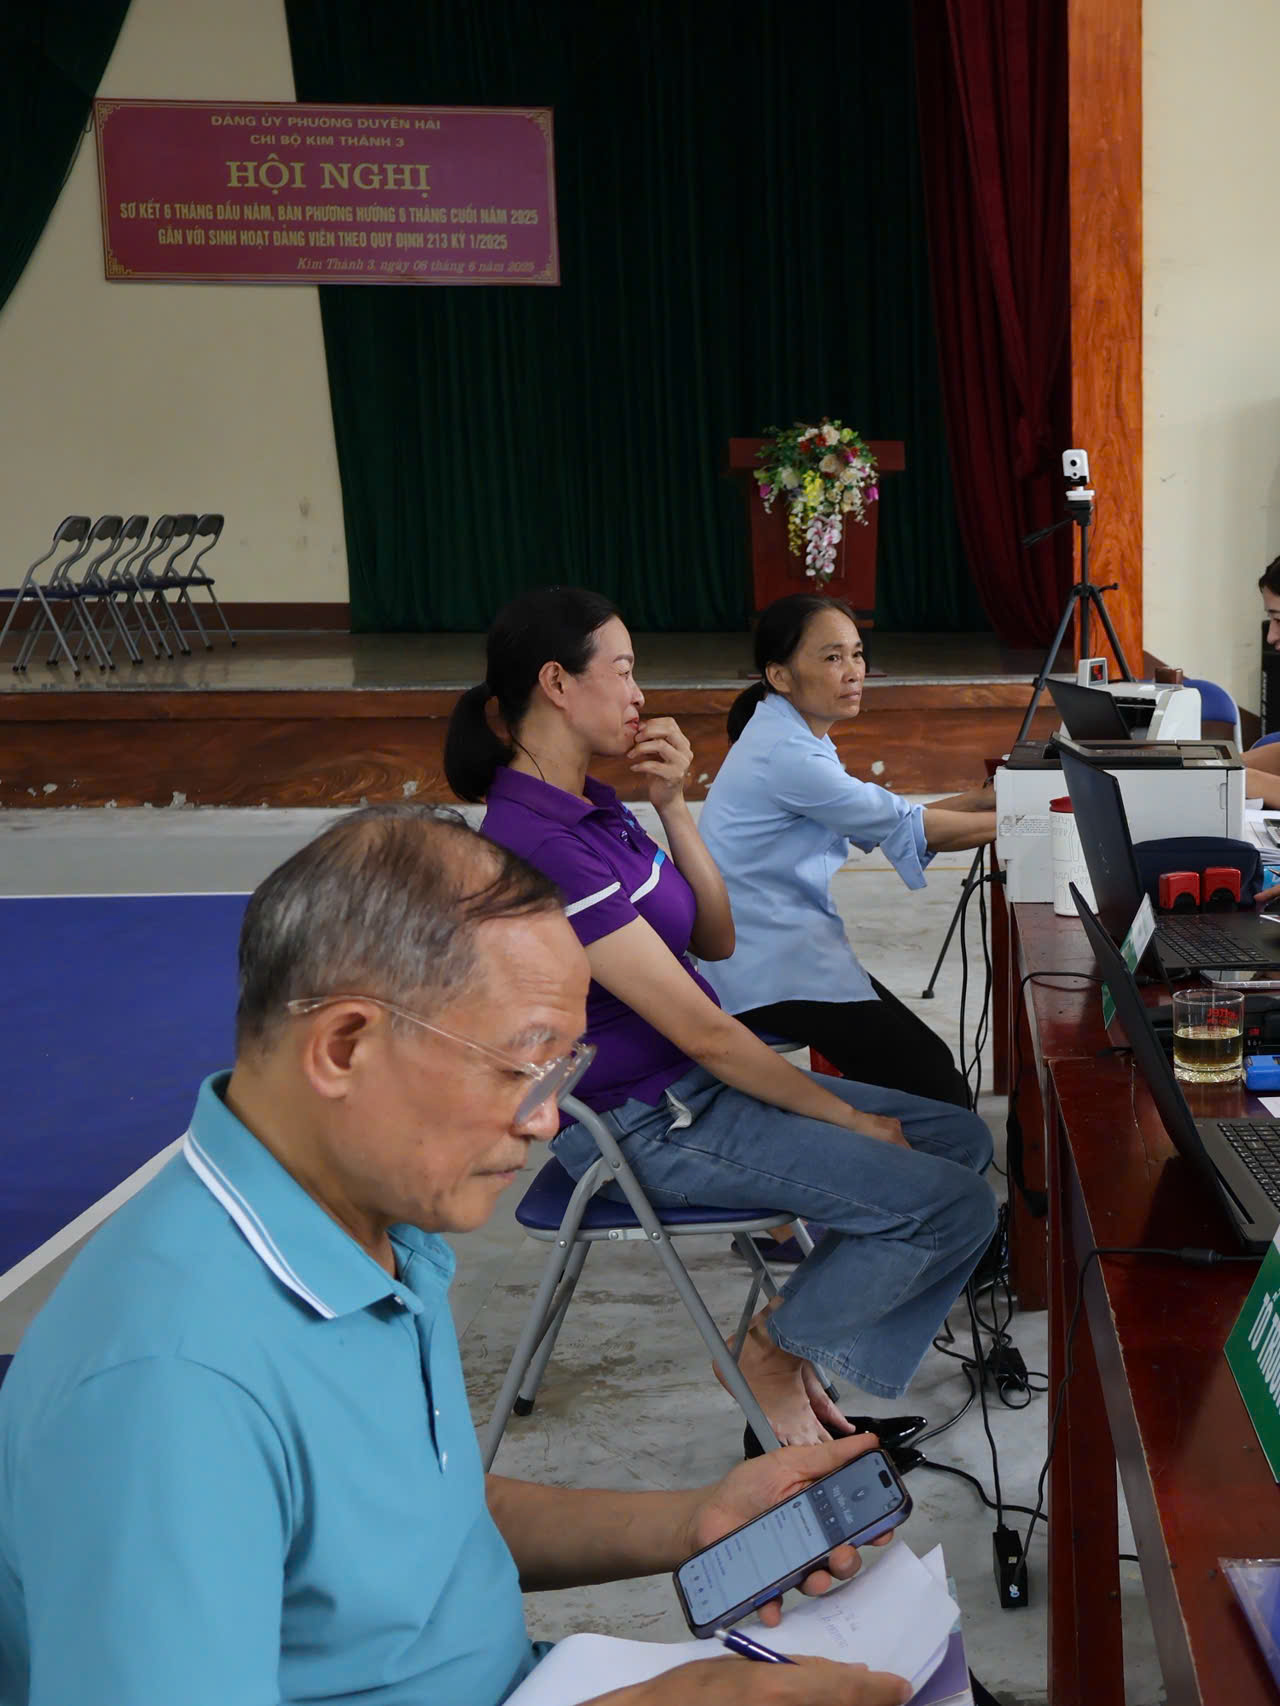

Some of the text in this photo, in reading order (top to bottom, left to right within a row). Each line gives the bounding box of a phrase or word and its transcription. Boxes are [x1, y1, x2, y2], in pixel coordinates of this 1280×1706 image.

[250, 134, 276, 145] CHI
[306, 134, 334, 146] KIM
[395, 137, 405, 148] 3
[226, 153, 432, 198] HỘI NGHỊ
[120, 201, 137, 219] SƠ
[139, 197, 161, 220] KẾT
[511, 208, 539, 225] 2025
[209, 228, 237, 246] SINH
[240, 229, 270, 251] HOẠT
[338, 231, 367, 248] THEO
[370, 231, 392, 249] QUY
[427, 232, 448, 249] 213
[469, 233, 508, 251] 1/2025
[296, 257, 322, 270] Kim
